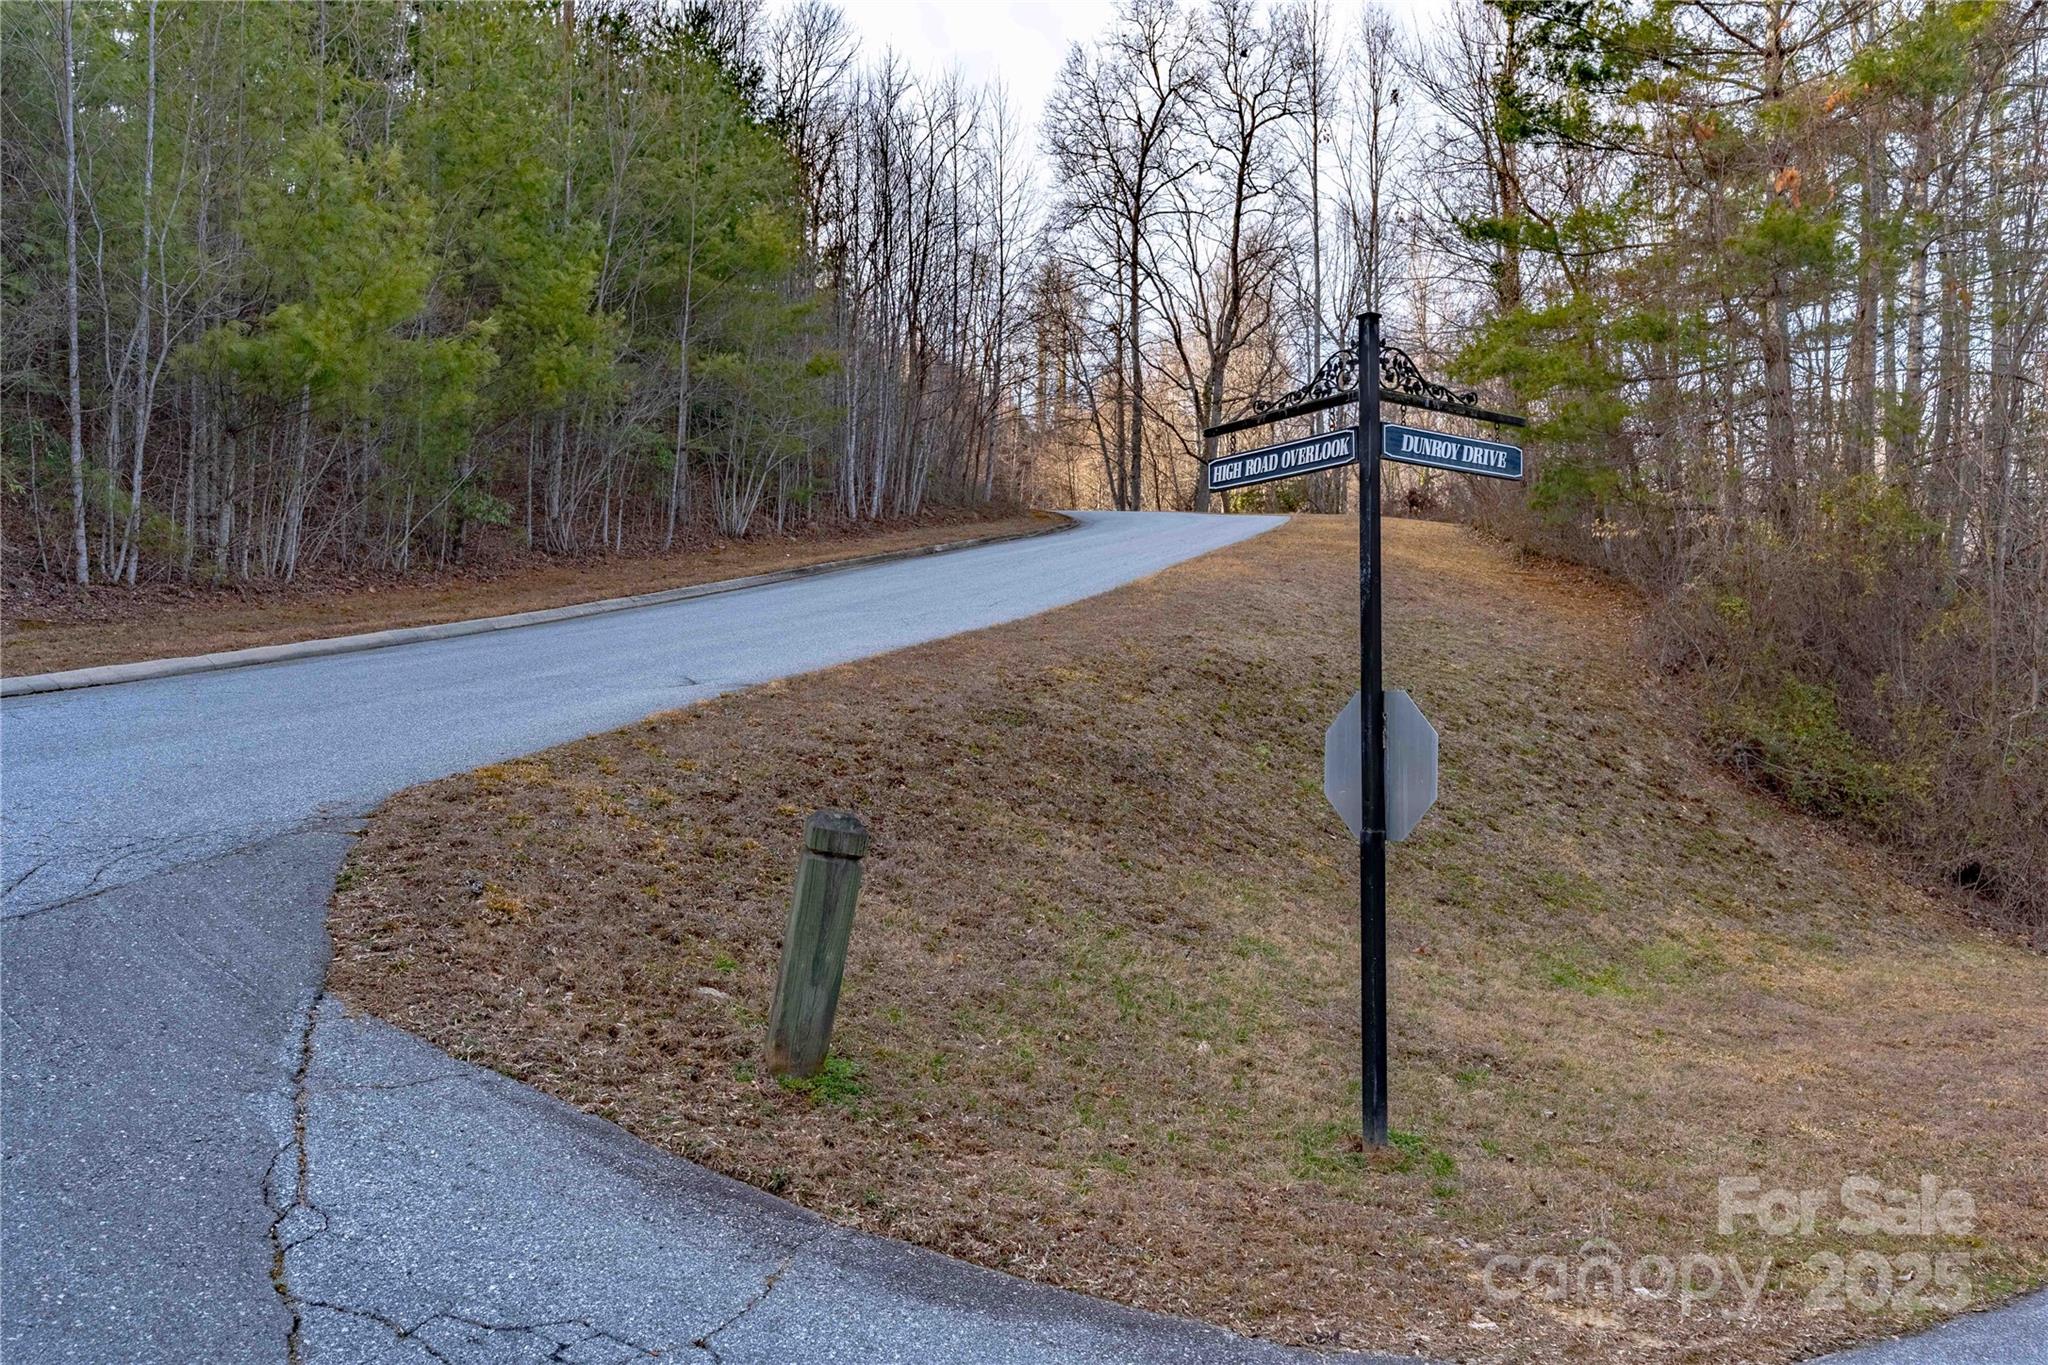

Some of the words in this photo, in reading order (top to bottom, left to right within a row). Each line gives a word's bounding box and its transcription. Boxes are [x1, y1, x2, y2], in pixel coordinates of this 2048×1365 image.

[1213, 461, 1242, 483] HIGH
[1245, 453, 1278, 477] ROAD
[1281, 436, 1350, 469] OVERLOOK
[1401, 434, 1461, 461] DUNROY
[1462, 444, 1507, 469] DRIVE
